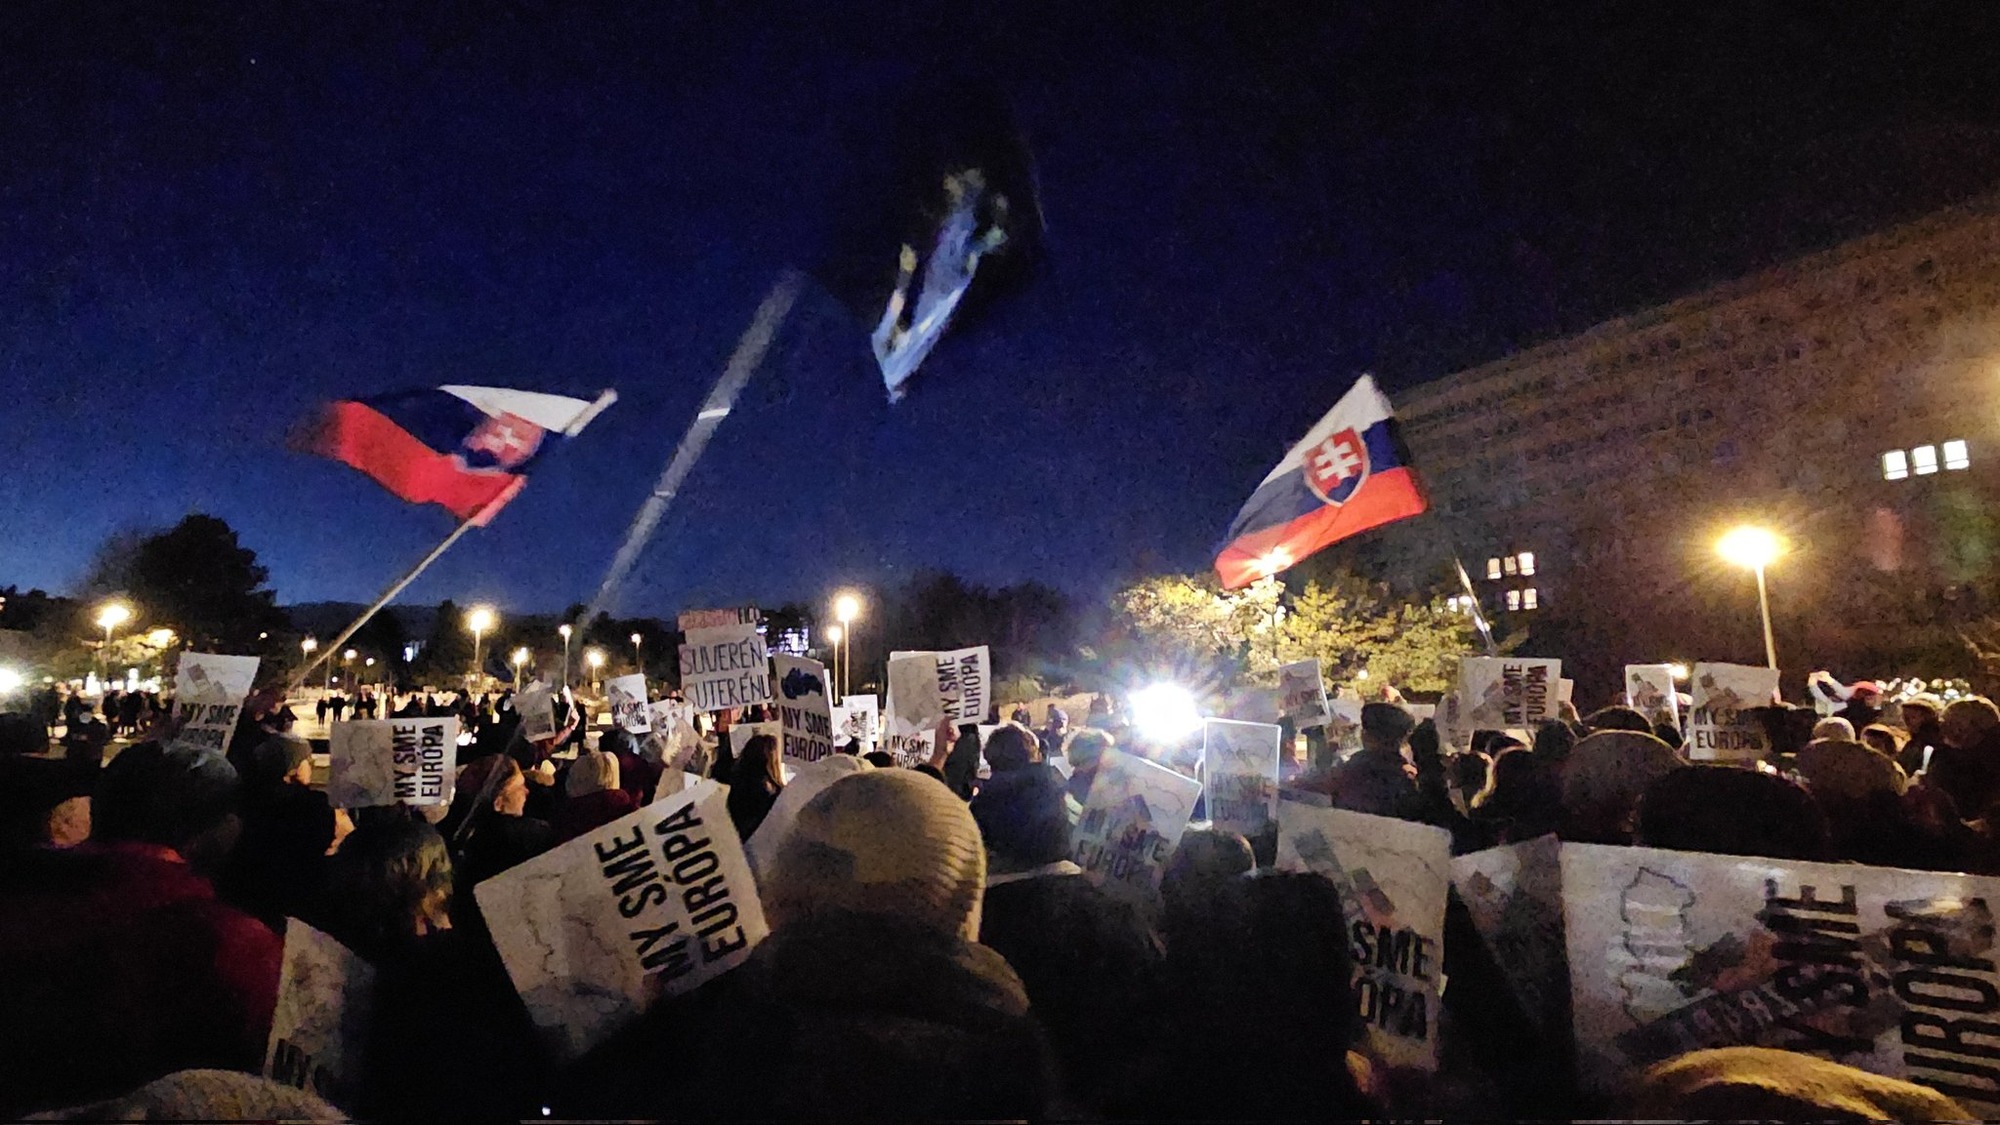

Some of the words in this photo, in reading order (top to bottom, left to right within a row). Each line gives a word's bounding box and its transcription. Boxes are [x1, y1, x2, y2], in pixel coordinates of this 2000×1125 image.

[680, 637, 764, 676] SUVERÉN
[936, 657, 959, 692] SME
[682, 671, 772, 709] SUTERÉNU
[781, 705, 801, 730] MY
[805, 711, 831, 740] SME
[392, 725, 416, 764] SME
[417, 725, 443, 797] EURÓPA
[783, 733, 834, 762] EURÓPA
[394, 769, 416, 797] MY
[594, 826, 667, 918] SME
[654, 802, 747, 964] EURÓPA
[630, 921, 693, 983] MY
[1352, 919, 1434, 982] SME
[1762, 877, 1869, 1006] SME
